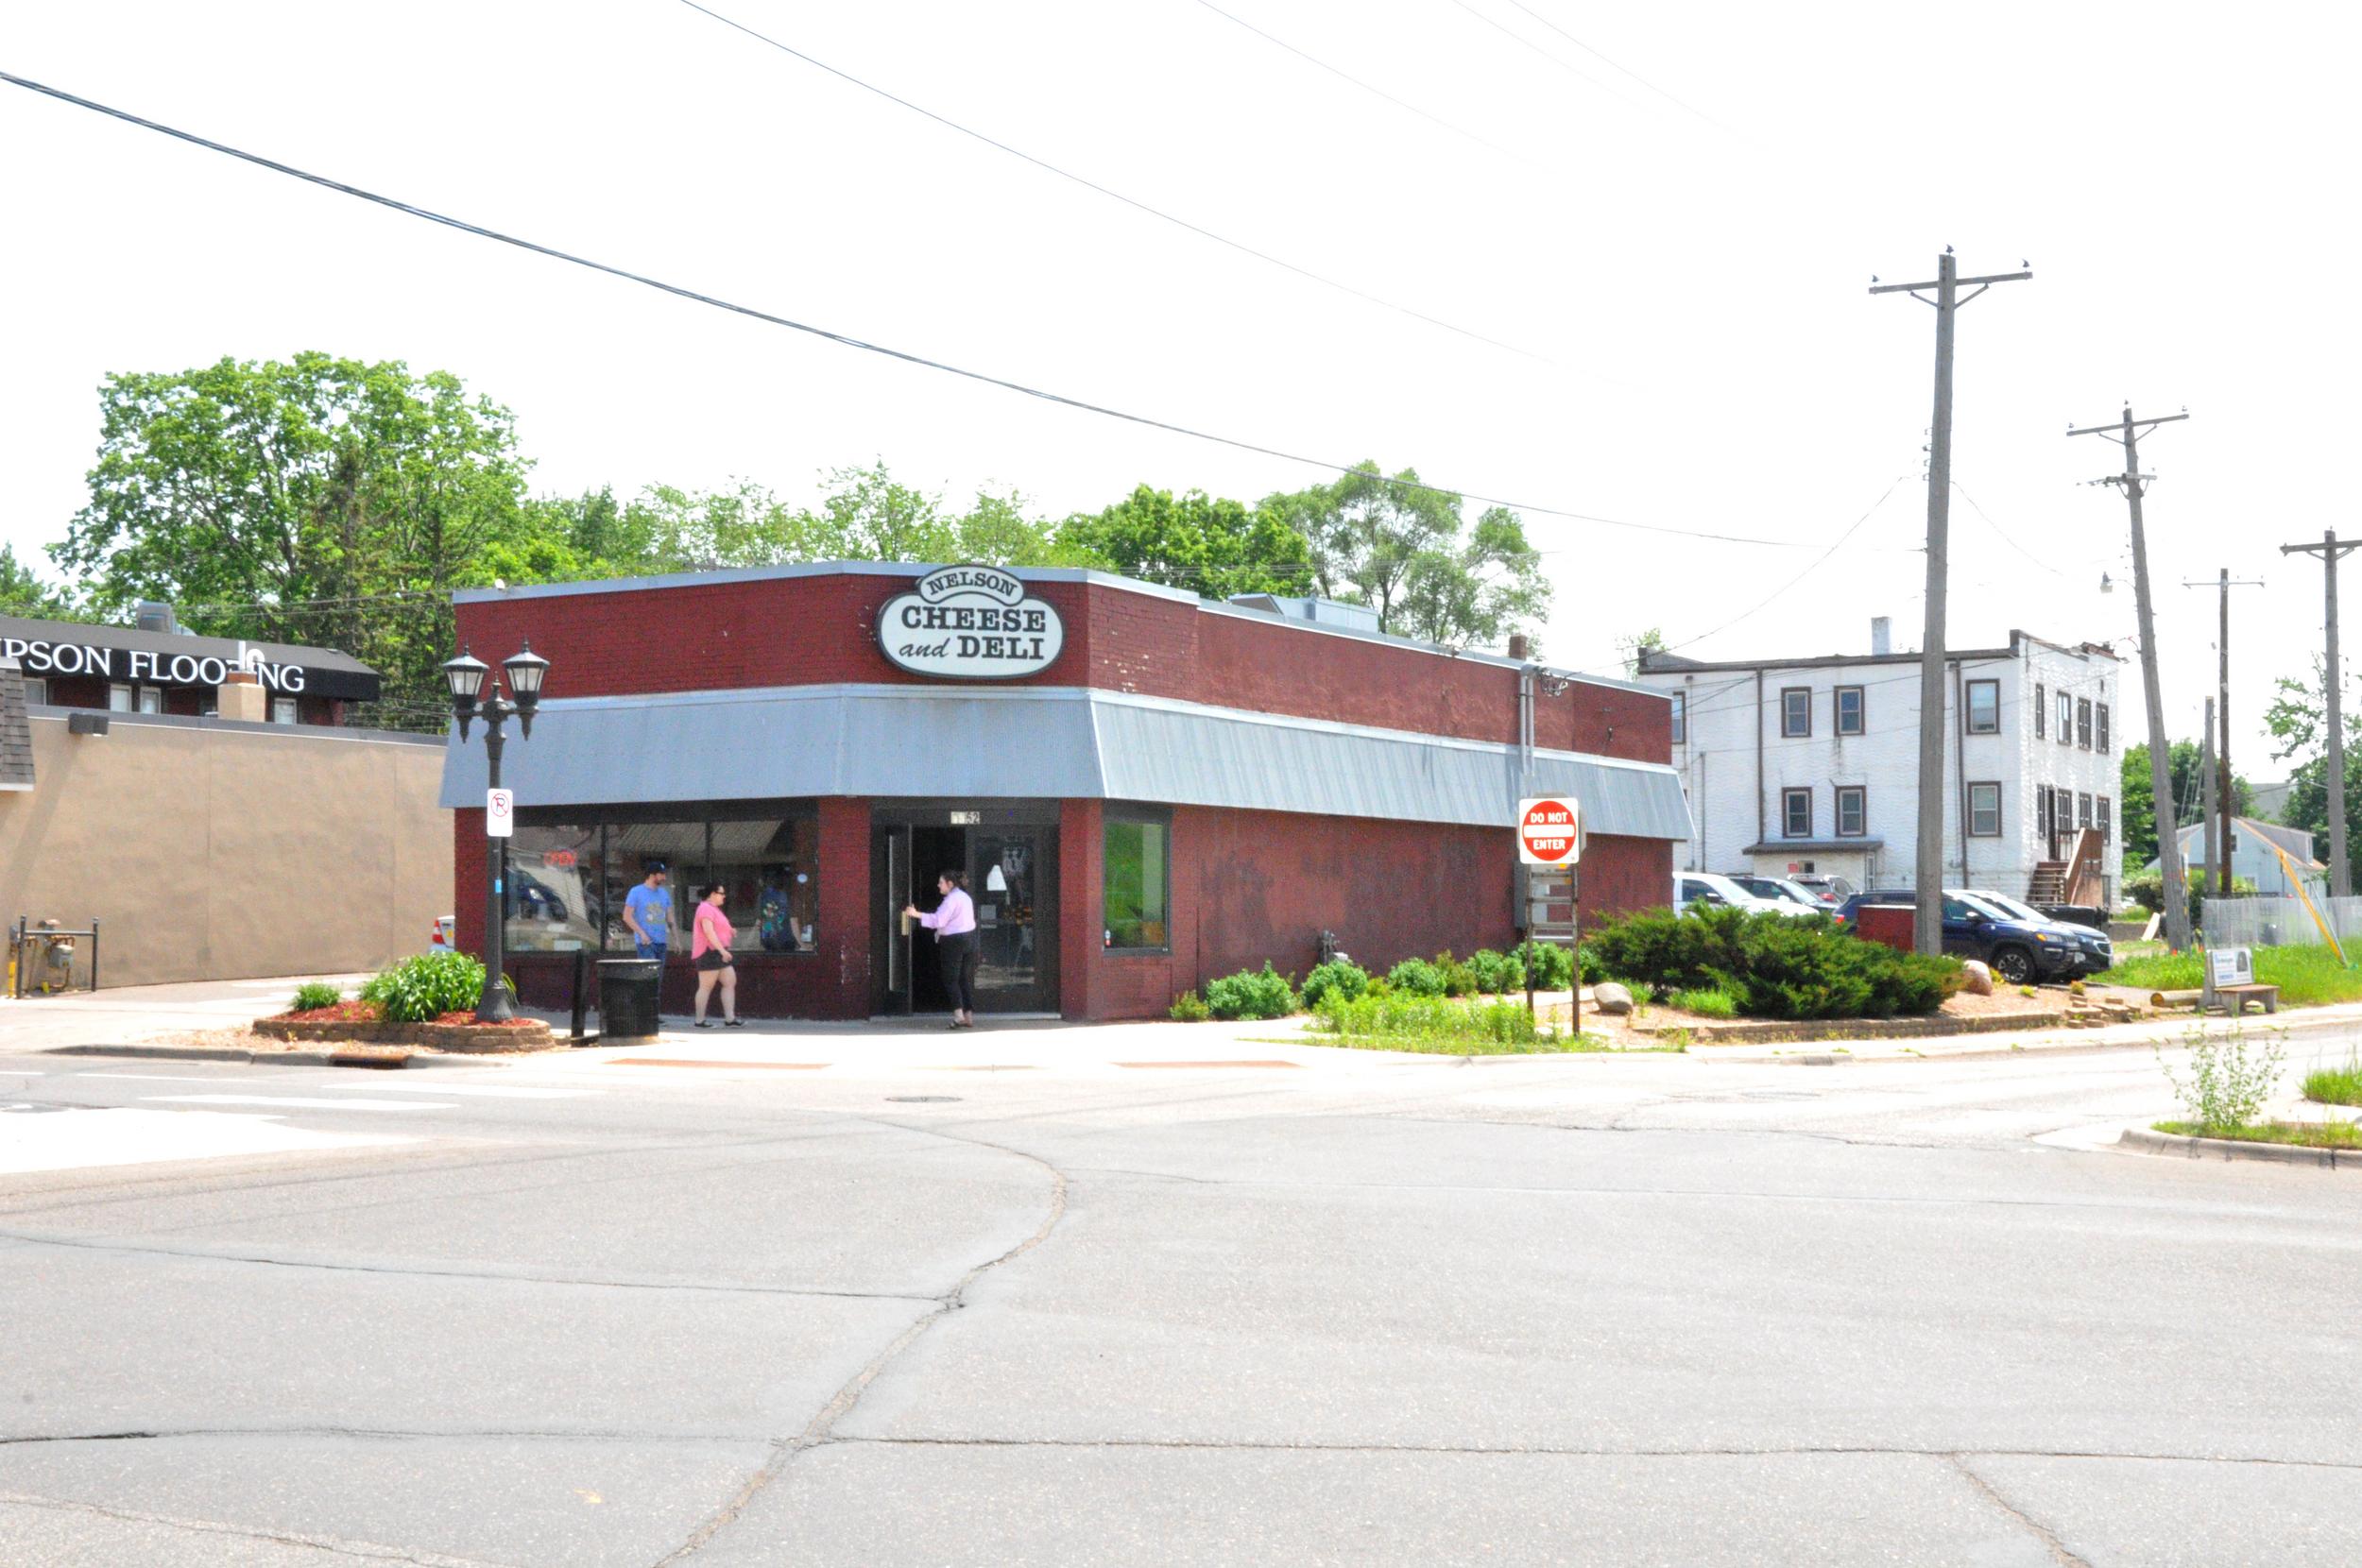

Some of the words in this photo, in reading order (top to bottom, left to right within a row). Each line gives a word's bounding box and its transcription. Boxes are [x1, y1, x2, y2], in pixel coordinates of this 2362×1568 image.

[926, 571, 1018, 597] NELSON
[901, 605, 1046, 633] CHEESE
[899, 637, 950, 658] and
[957, 636, 1044, 660] DELI
[0, 638, 111, 676] PSON
[129, 651, 304, 691] FLOONG
[1531, 812, 1545, 824] DO
[1548, 811, 1567, 824] NOT
[1532, 839, 1566, 850] ENTER
